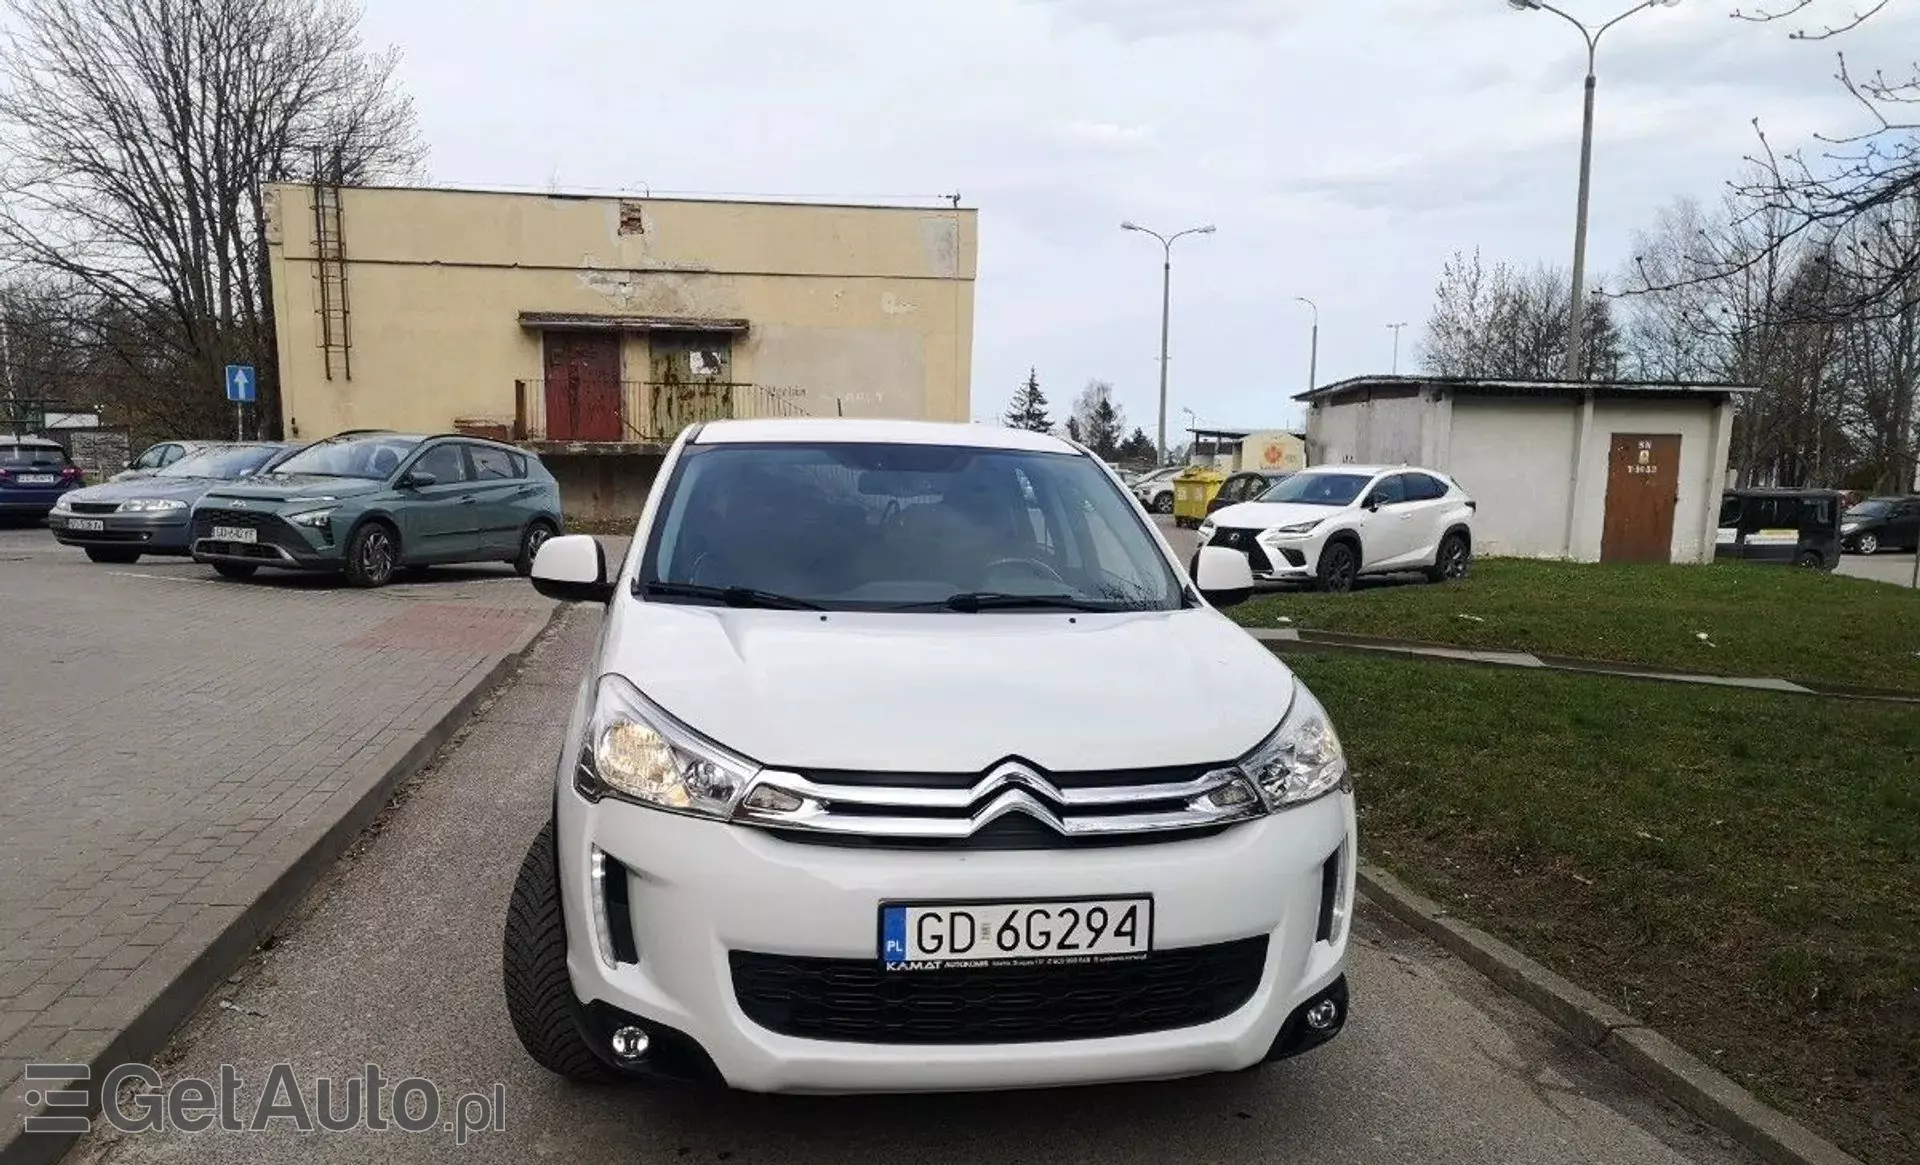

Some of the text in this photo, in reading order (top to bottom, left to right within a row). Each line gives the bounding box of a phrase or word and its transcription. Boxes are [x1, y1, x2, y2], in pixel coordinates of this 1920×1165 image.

[916, 904, 1138, 954] GD 6G294
[886, 940, 903, 952] PL
[886, 961, 942, 971] KAMAT
